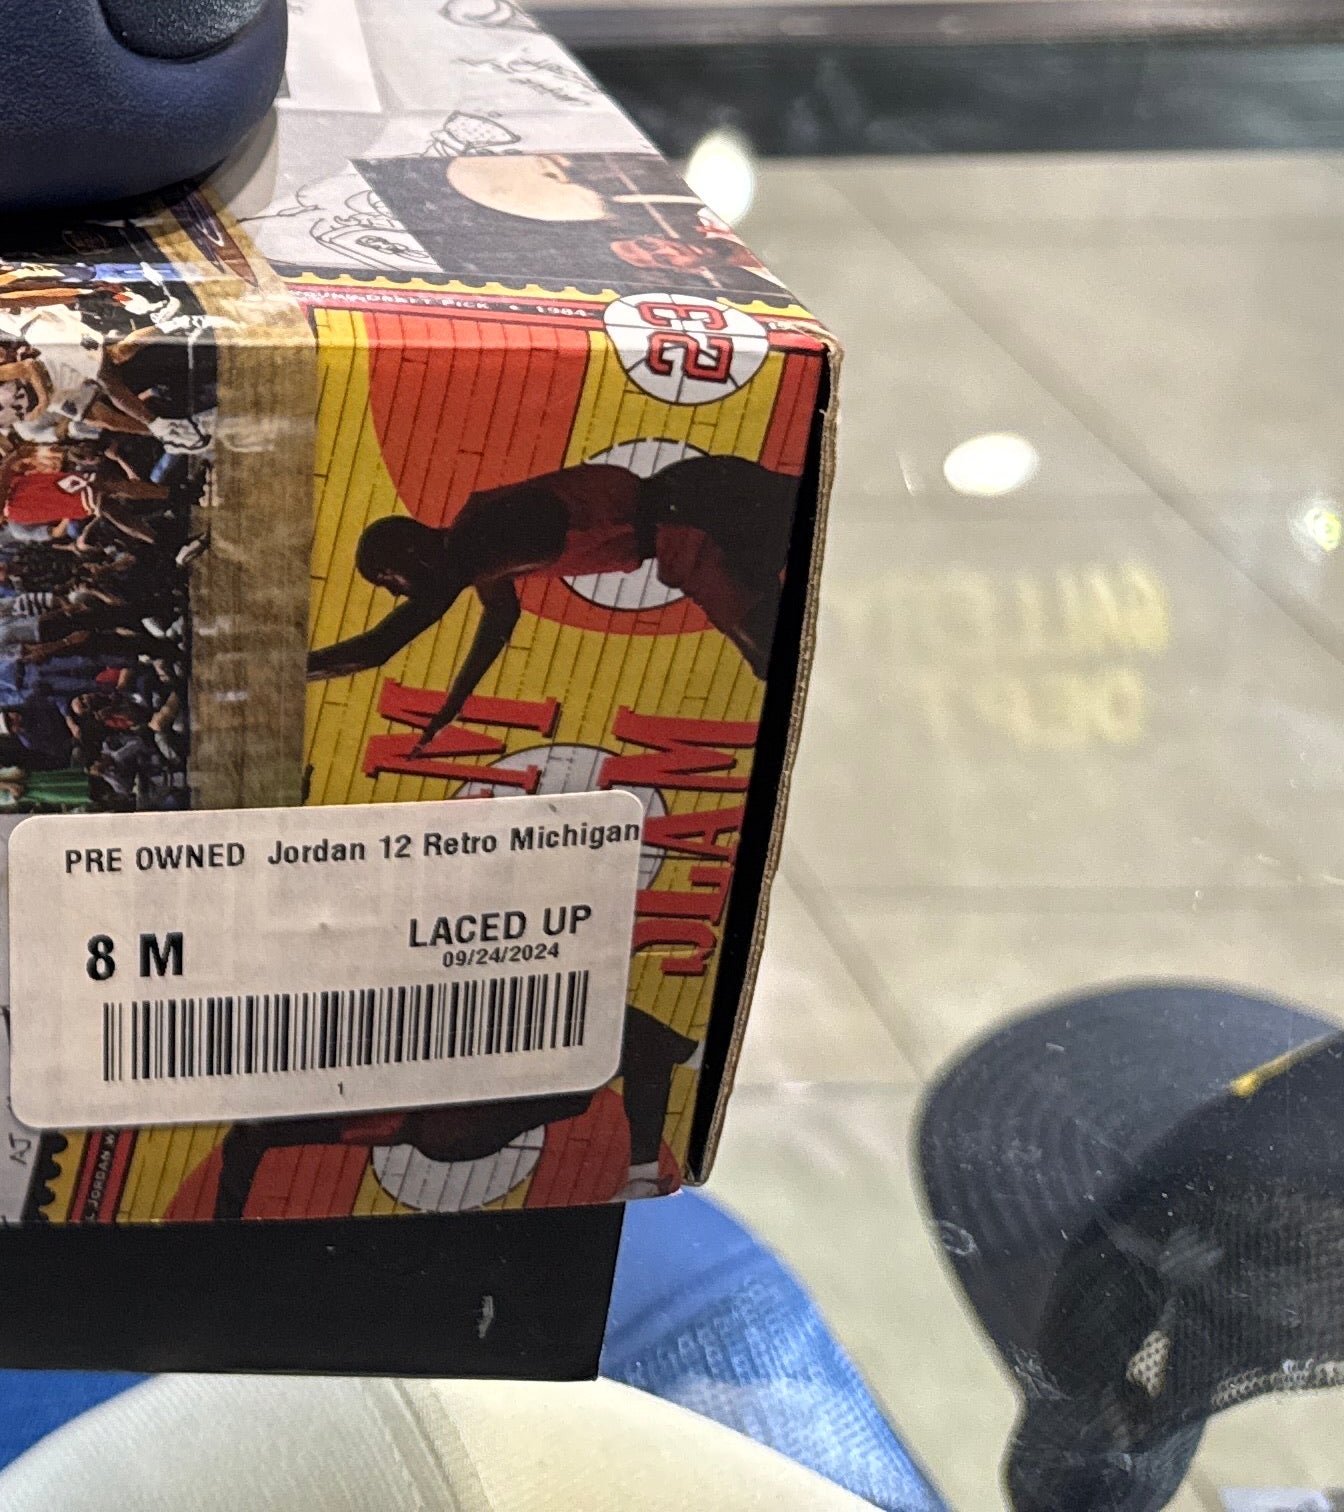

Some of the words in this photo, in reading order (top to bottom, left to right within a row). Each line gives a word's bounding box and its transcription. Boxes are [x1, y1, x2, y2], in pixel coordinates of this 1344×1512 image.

[440, 297, 490, 310] PICK
[634, 300, 732, 384] 23
[64, 849, 122, 875] PRE
[135, 842, 246, 871] OWNED
[267, 838, 366, 867] Jordan
[378, 834, 412, 861] 12
[423, 829, 498, 858] Retro
[509, 820, 641, 854] Michigan
[408, 911, 527, 949] LACED
[541, 904, 593, 938] UP
[85, 933, 117, 981] 8
[139, 931, 185, 978] M
[441, 941, 560, 969] 09/24/2024
[336, 1082, 345, 1096] 1
[88, 1150, 111, 1209] JORDAN
